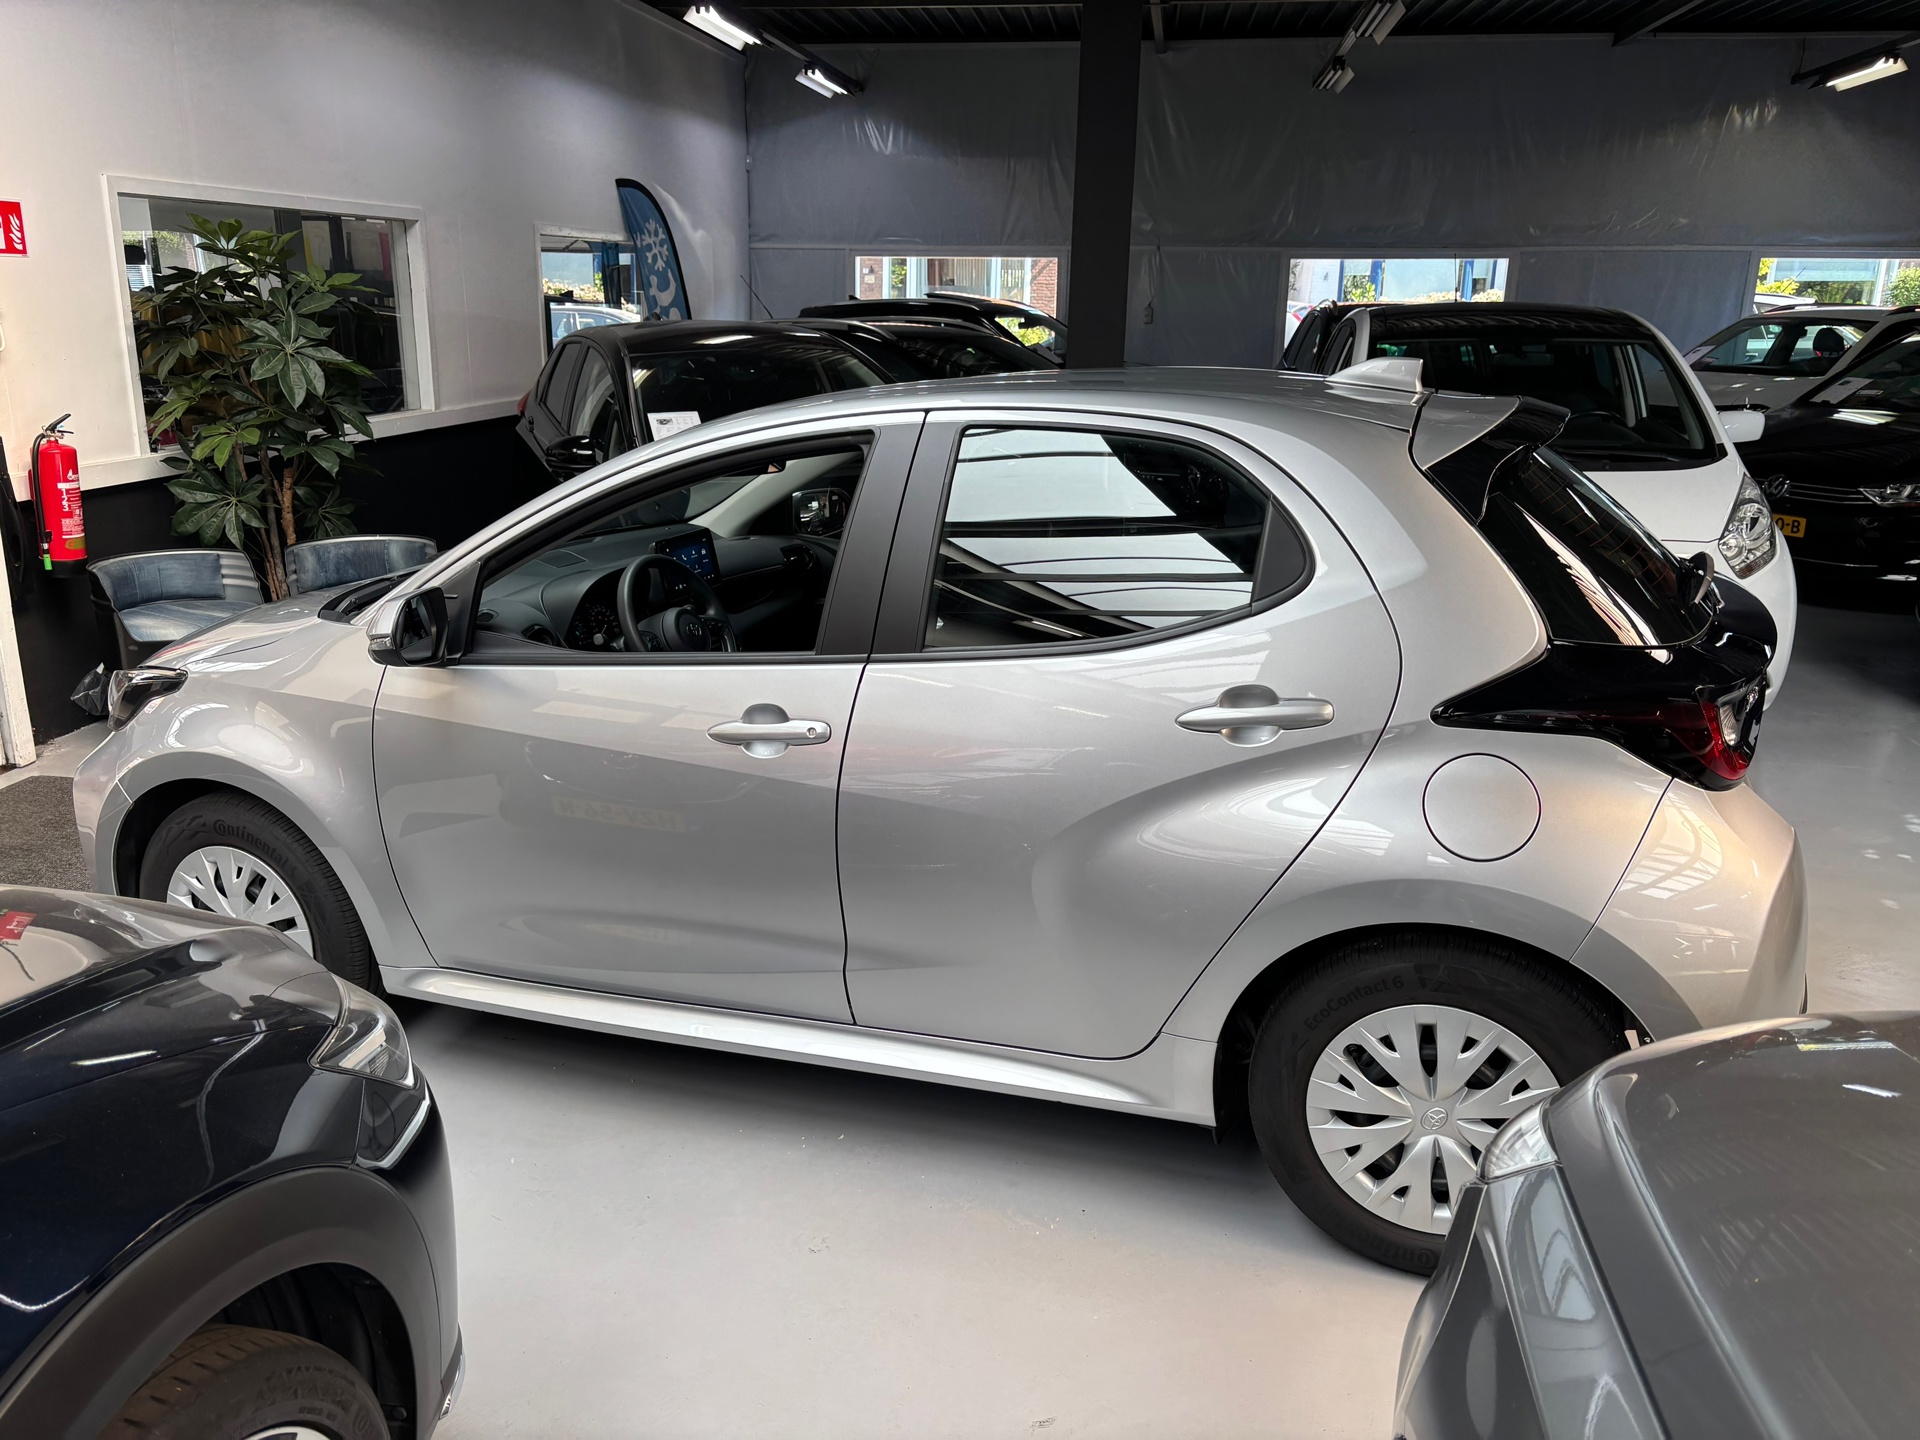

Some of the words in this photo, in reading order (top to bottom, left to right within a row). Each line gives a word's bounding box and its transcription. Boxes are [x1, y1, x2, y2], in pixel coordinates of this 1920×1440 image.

[213, 819, 289, 868] Continental
[1304, 979, 1391, 1031] EcoContact
[1393, 976, 1404, 989] 6
